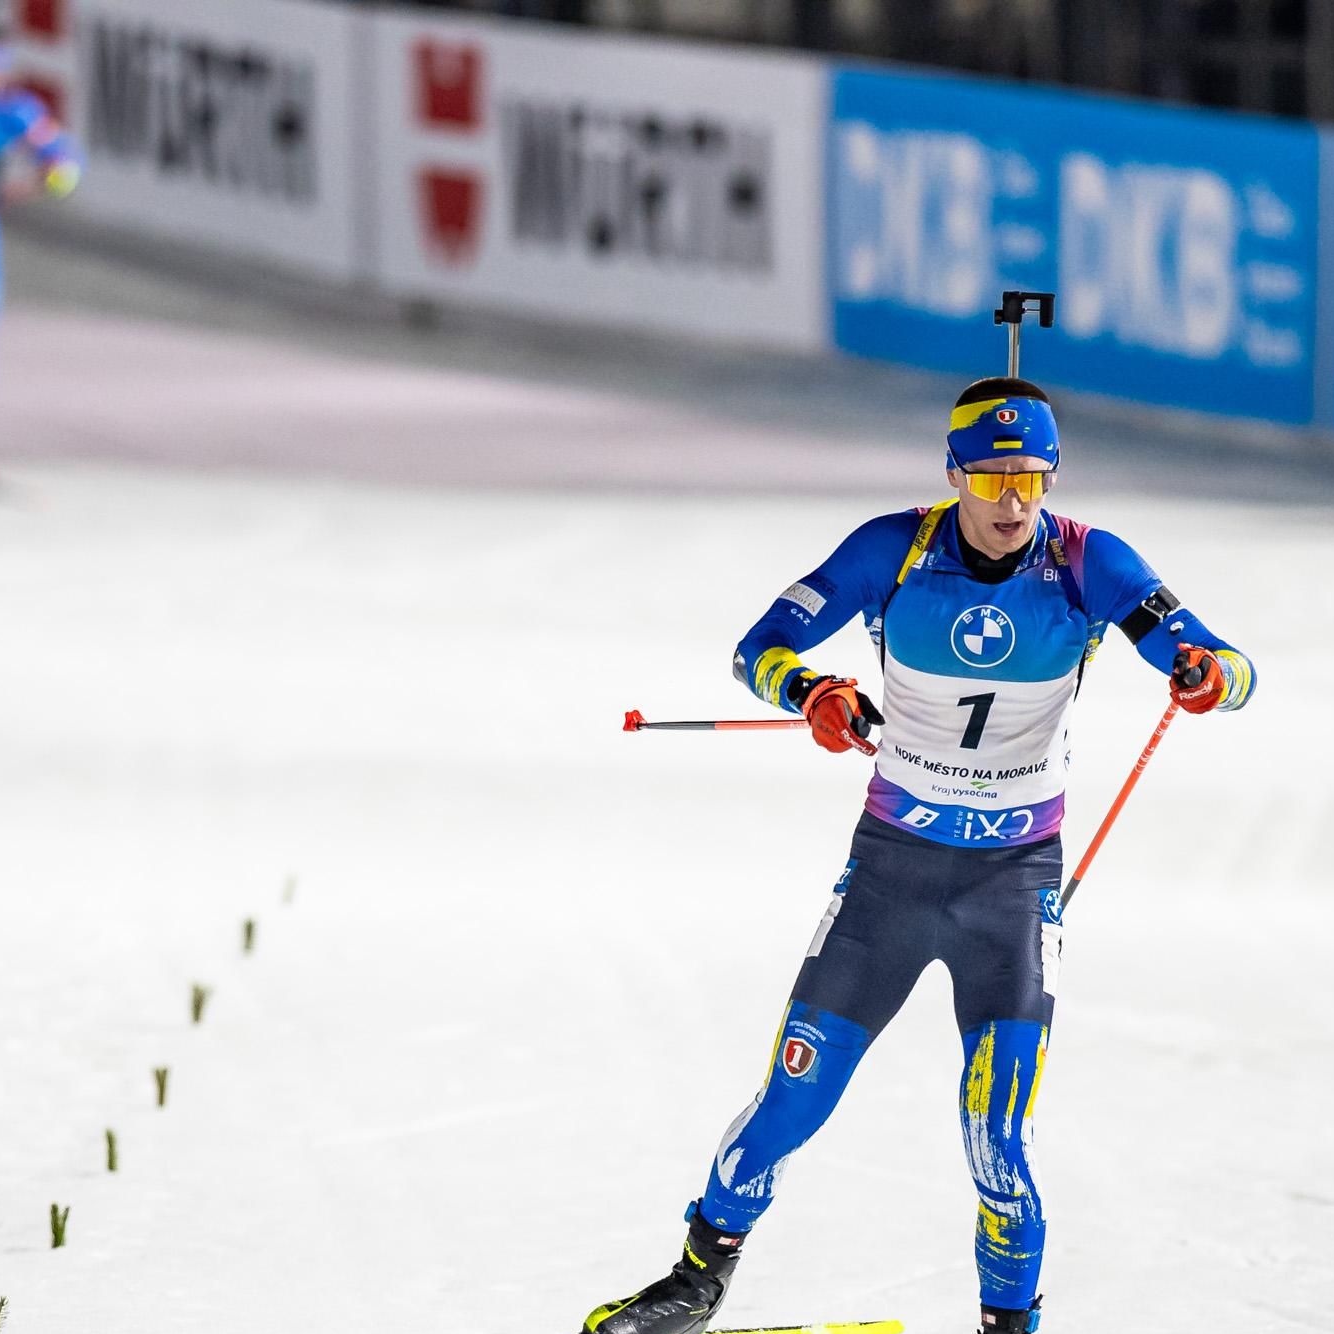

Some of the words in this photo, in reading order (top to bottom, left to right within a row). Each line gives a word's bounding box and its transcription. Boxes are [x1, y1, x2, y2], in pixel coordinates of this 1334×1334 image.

[833, 118, 990, 317] DKB
[1060, 152, 1235, 359] DKB
[962, 608, 1008, 627] BMW
[957, 692, 996, 750] 1
[895, 745, 922, 766] NOVÉ
[923, 759, 969, 778] MĚSTO
[972, 769, 993, 780] NA
[996, 758, 1049, 780] MORAVĚ
[931, 784, 951, 796] Kraj
[788, 1045, 804, 1070] 1
